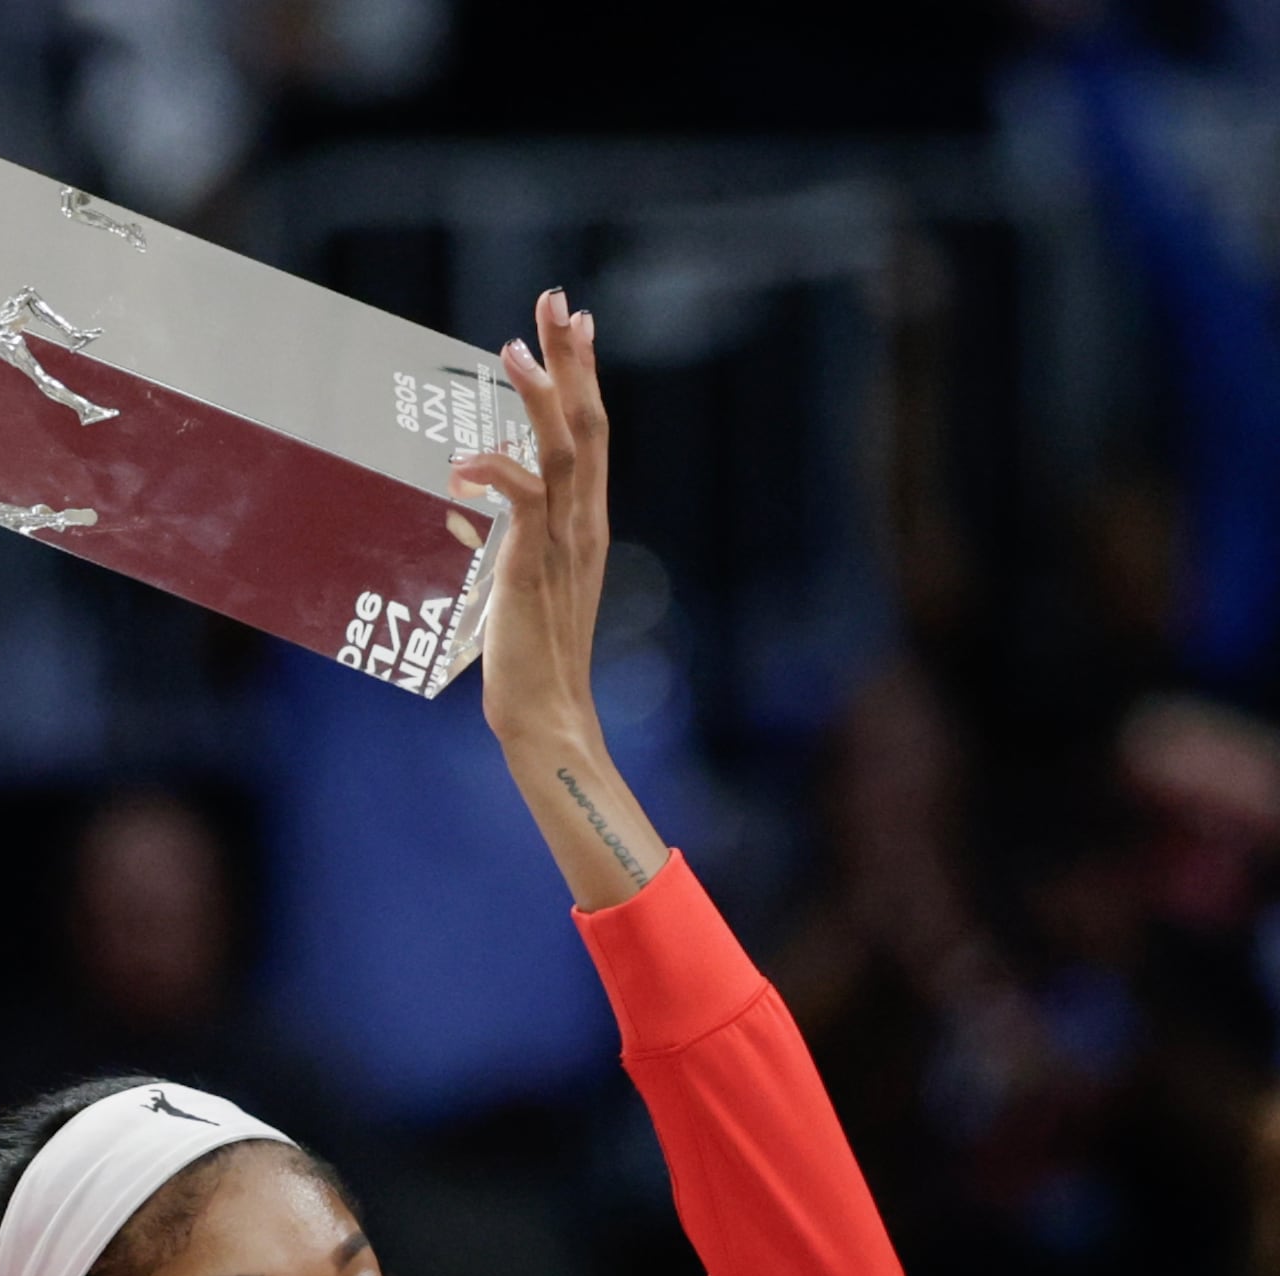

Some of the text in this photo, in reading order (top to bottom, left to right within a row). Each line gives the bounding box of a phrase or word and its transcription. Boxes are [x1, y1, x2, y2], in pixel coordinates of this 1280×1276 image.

[336, 591, 382, 670] 026
[396, 597, 453, 695] NBA
[557, 768, 648, 889] UNAPOLOGETI
